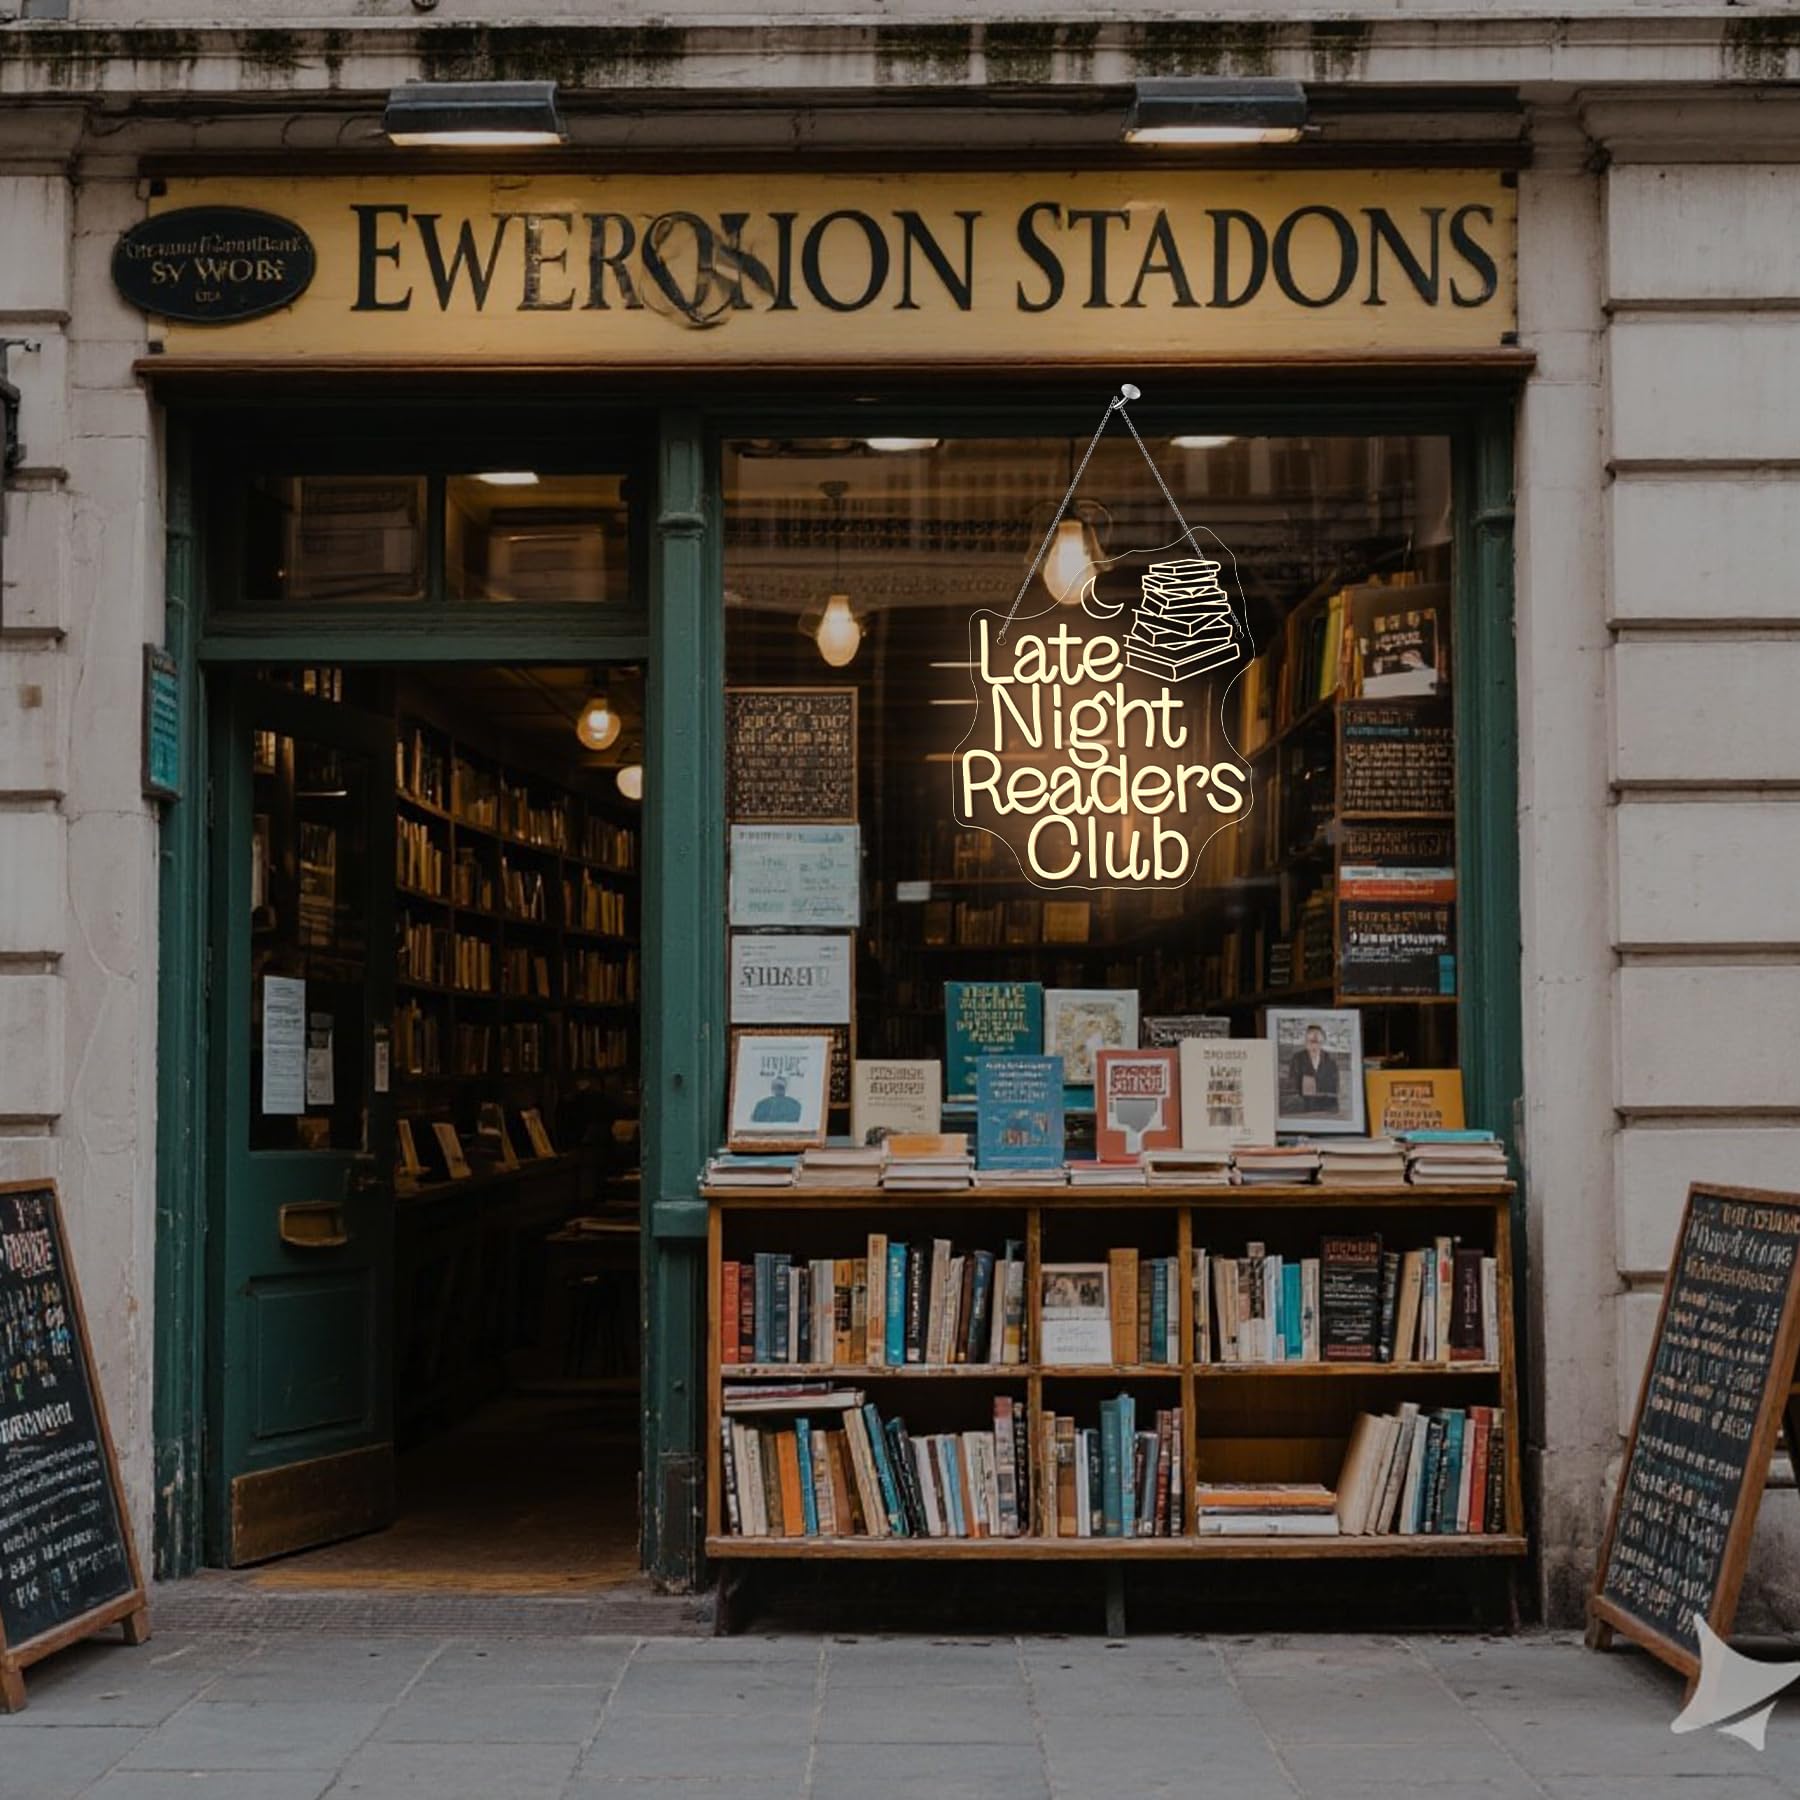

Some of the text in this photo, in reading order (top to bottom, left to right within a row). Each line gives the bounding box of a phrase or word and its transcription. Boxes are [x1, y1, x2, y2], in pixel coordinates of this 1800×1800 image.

[1016, 201, 1498, 313] STADONS
[979, 618, 1124, 686] Late
[991, 682, 1188, 769] Night
[962, 749, 1246, 818] Readers
[1027, 814, 1190, 881] Club
